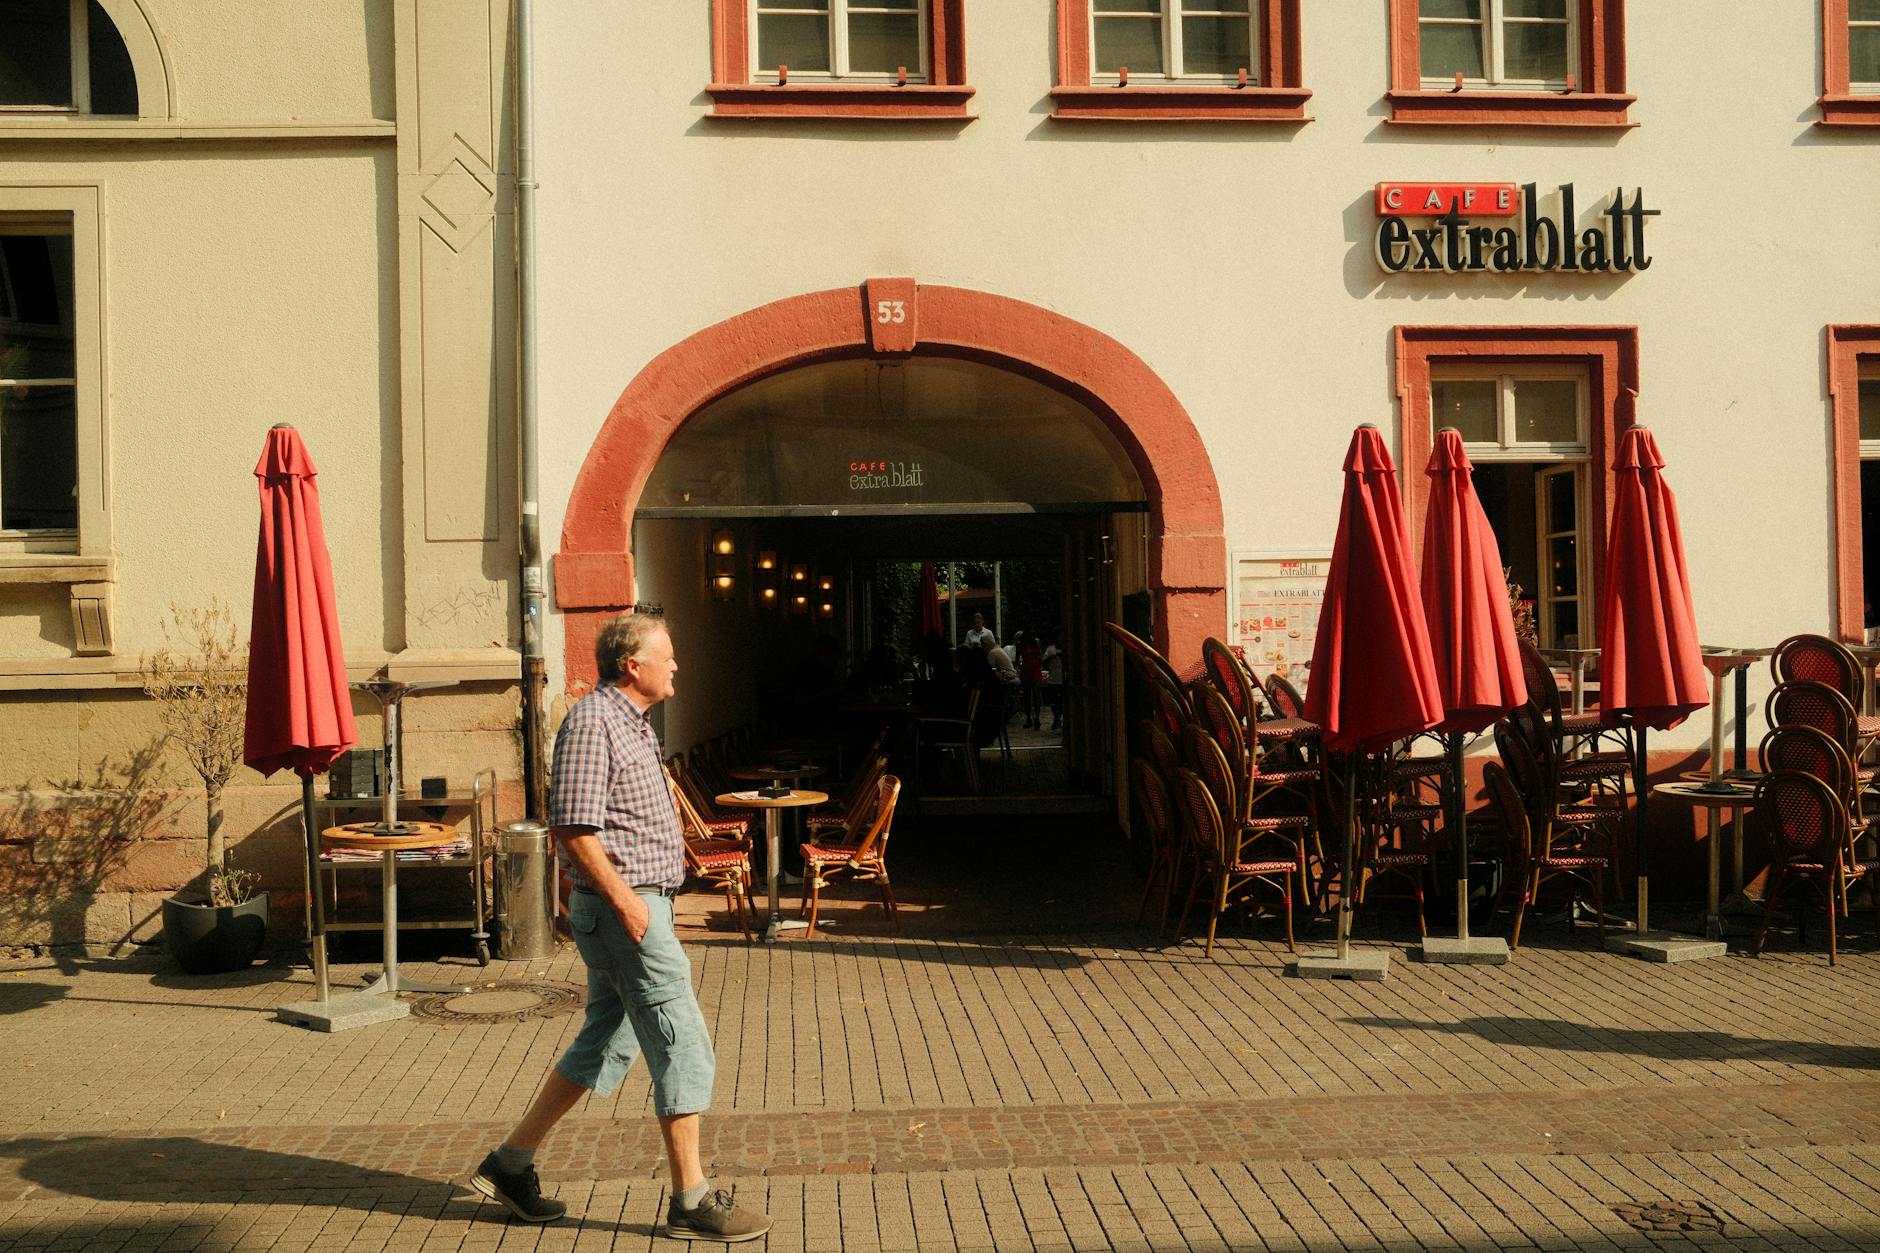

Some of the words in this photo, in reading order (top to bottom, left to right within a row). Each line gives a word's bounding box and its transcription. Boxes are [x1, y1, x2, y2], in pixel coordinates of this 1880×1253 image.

[1385, 188, 1511, 209] CAFE
[1376, 182, 1661, 272] extrablatt
[877, 301, 906, 324] 53
[850, 462, 886, 471] CAFE
